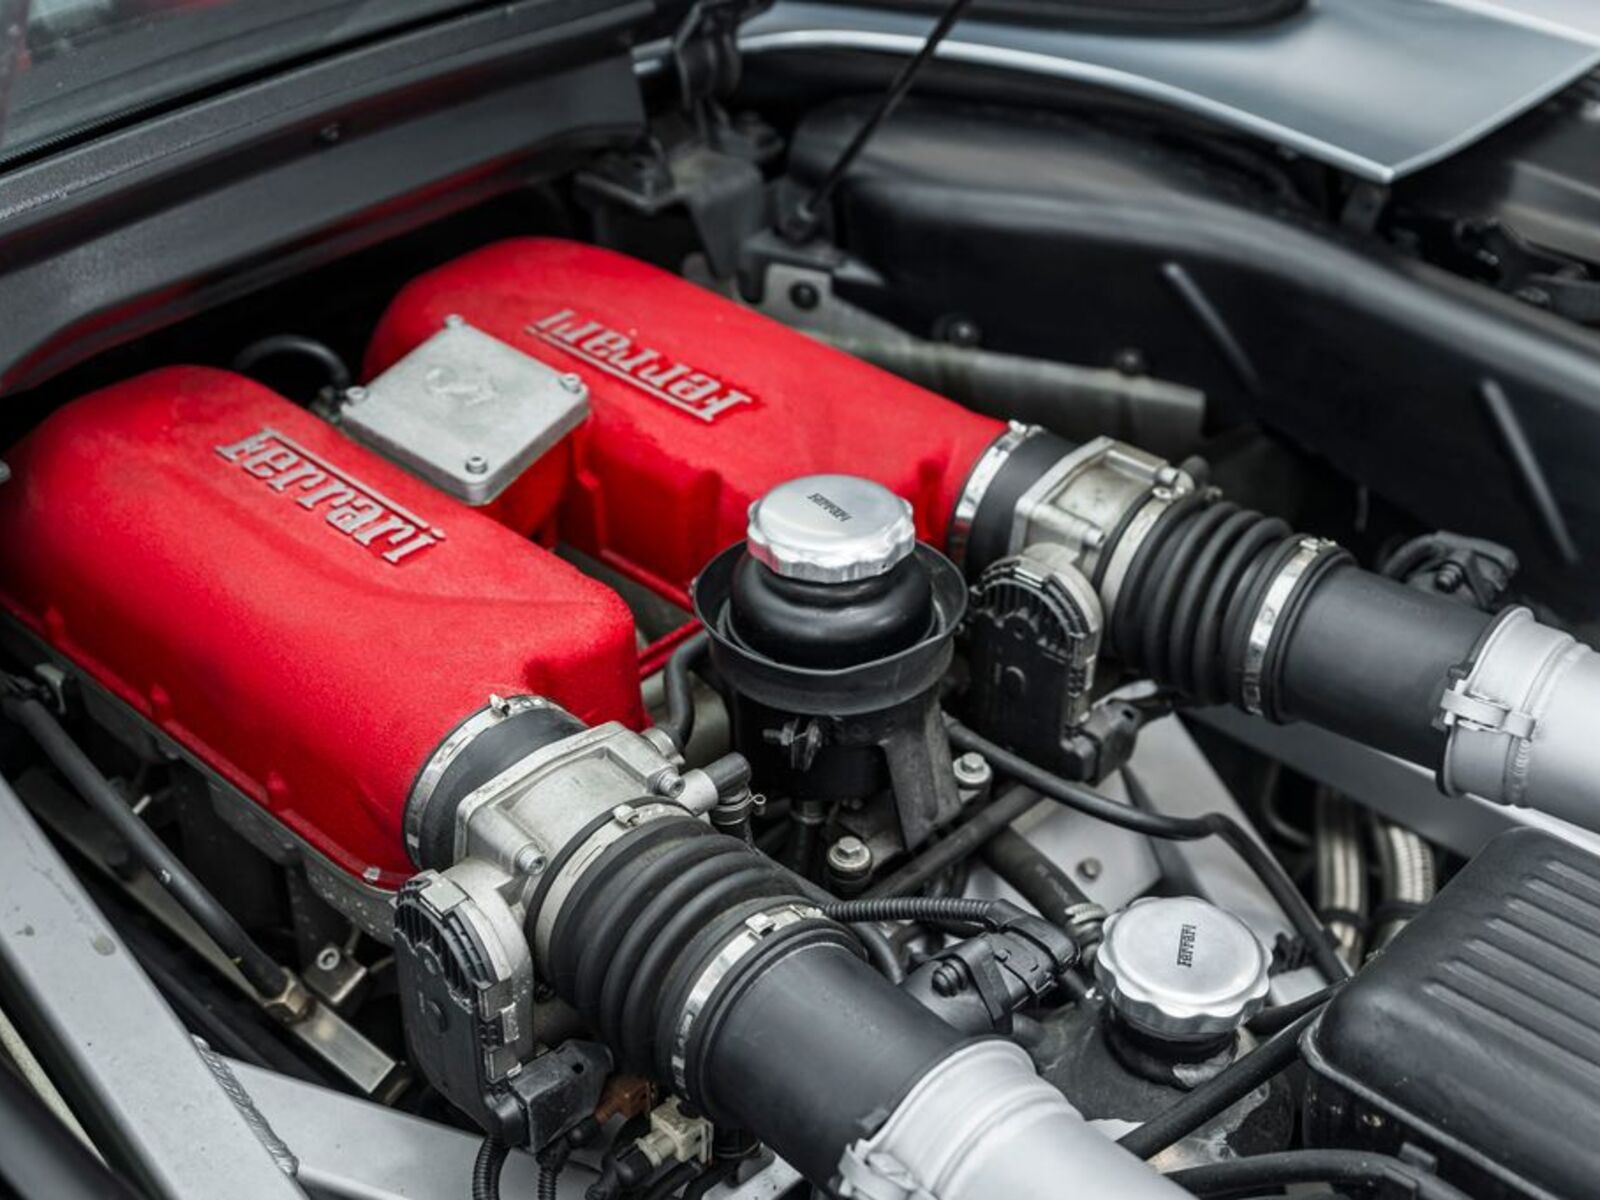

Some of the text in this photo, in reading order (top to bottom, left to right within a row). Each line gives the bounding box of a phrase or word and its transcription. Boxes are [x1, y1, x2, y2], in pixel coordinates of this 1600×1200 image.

[523, 308, 753, 423] Ferrari
[214, 426, 446, 564] Ferrari
[1176, 923, 1196, 968] Ferrari
